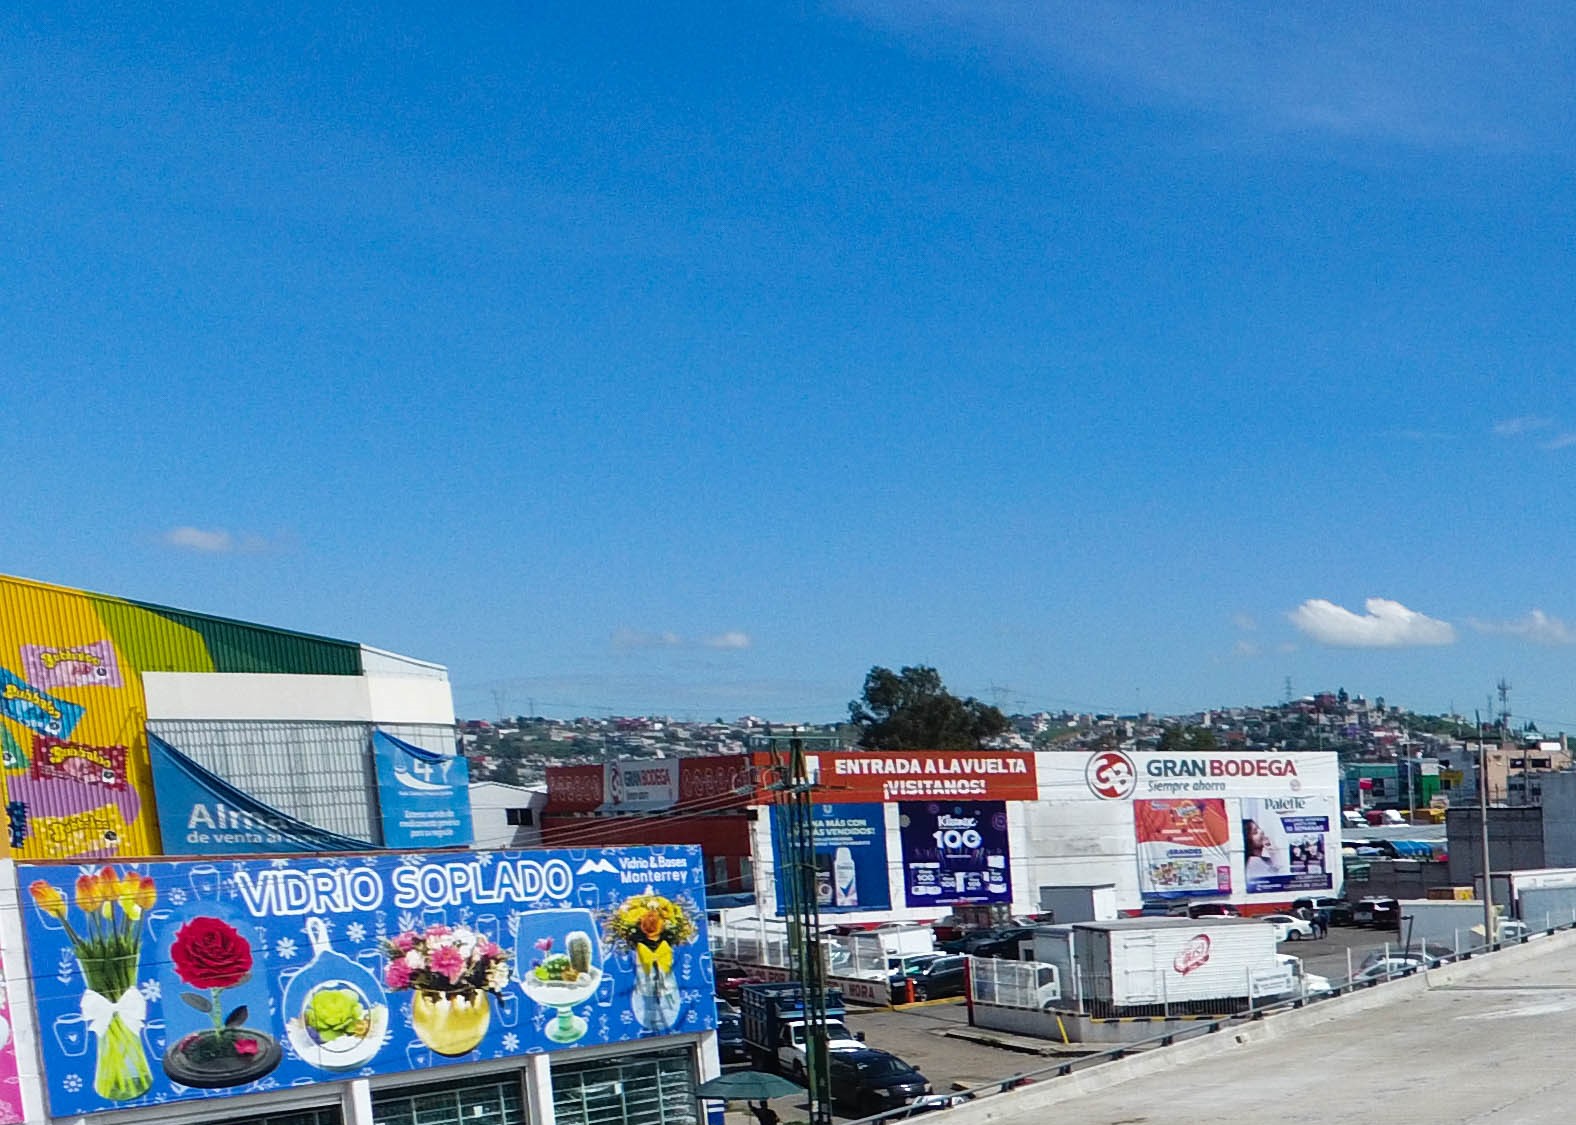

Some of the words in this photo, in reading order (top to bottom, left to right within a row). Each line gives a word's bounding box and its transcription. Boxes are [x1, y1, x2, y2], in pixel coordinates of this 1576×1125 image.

[834, 759, 923, 775] ENTRADA
[924, 759, 938, 774] A
[1146, 759, 1206, 777] GRAN
[1209, 759, 1297, 777] BODEGA
[883, 779, 986, 799] ¡VISITANOS!
[1148, 780, 1189, 794] Siempre
[1192, 780, 1226, 792] ahorro
[187, 832, 209, 843] de
[211, 833, 263, 843] venta
[619, 857, 648, 869] Vidrio
[658, 857, 688, 868] Bases
[620, 870, 688, 884] Monterrey
[237, 866, 384, 917] VIDRIO
[393, 858, 574, 908] SOPLADO
